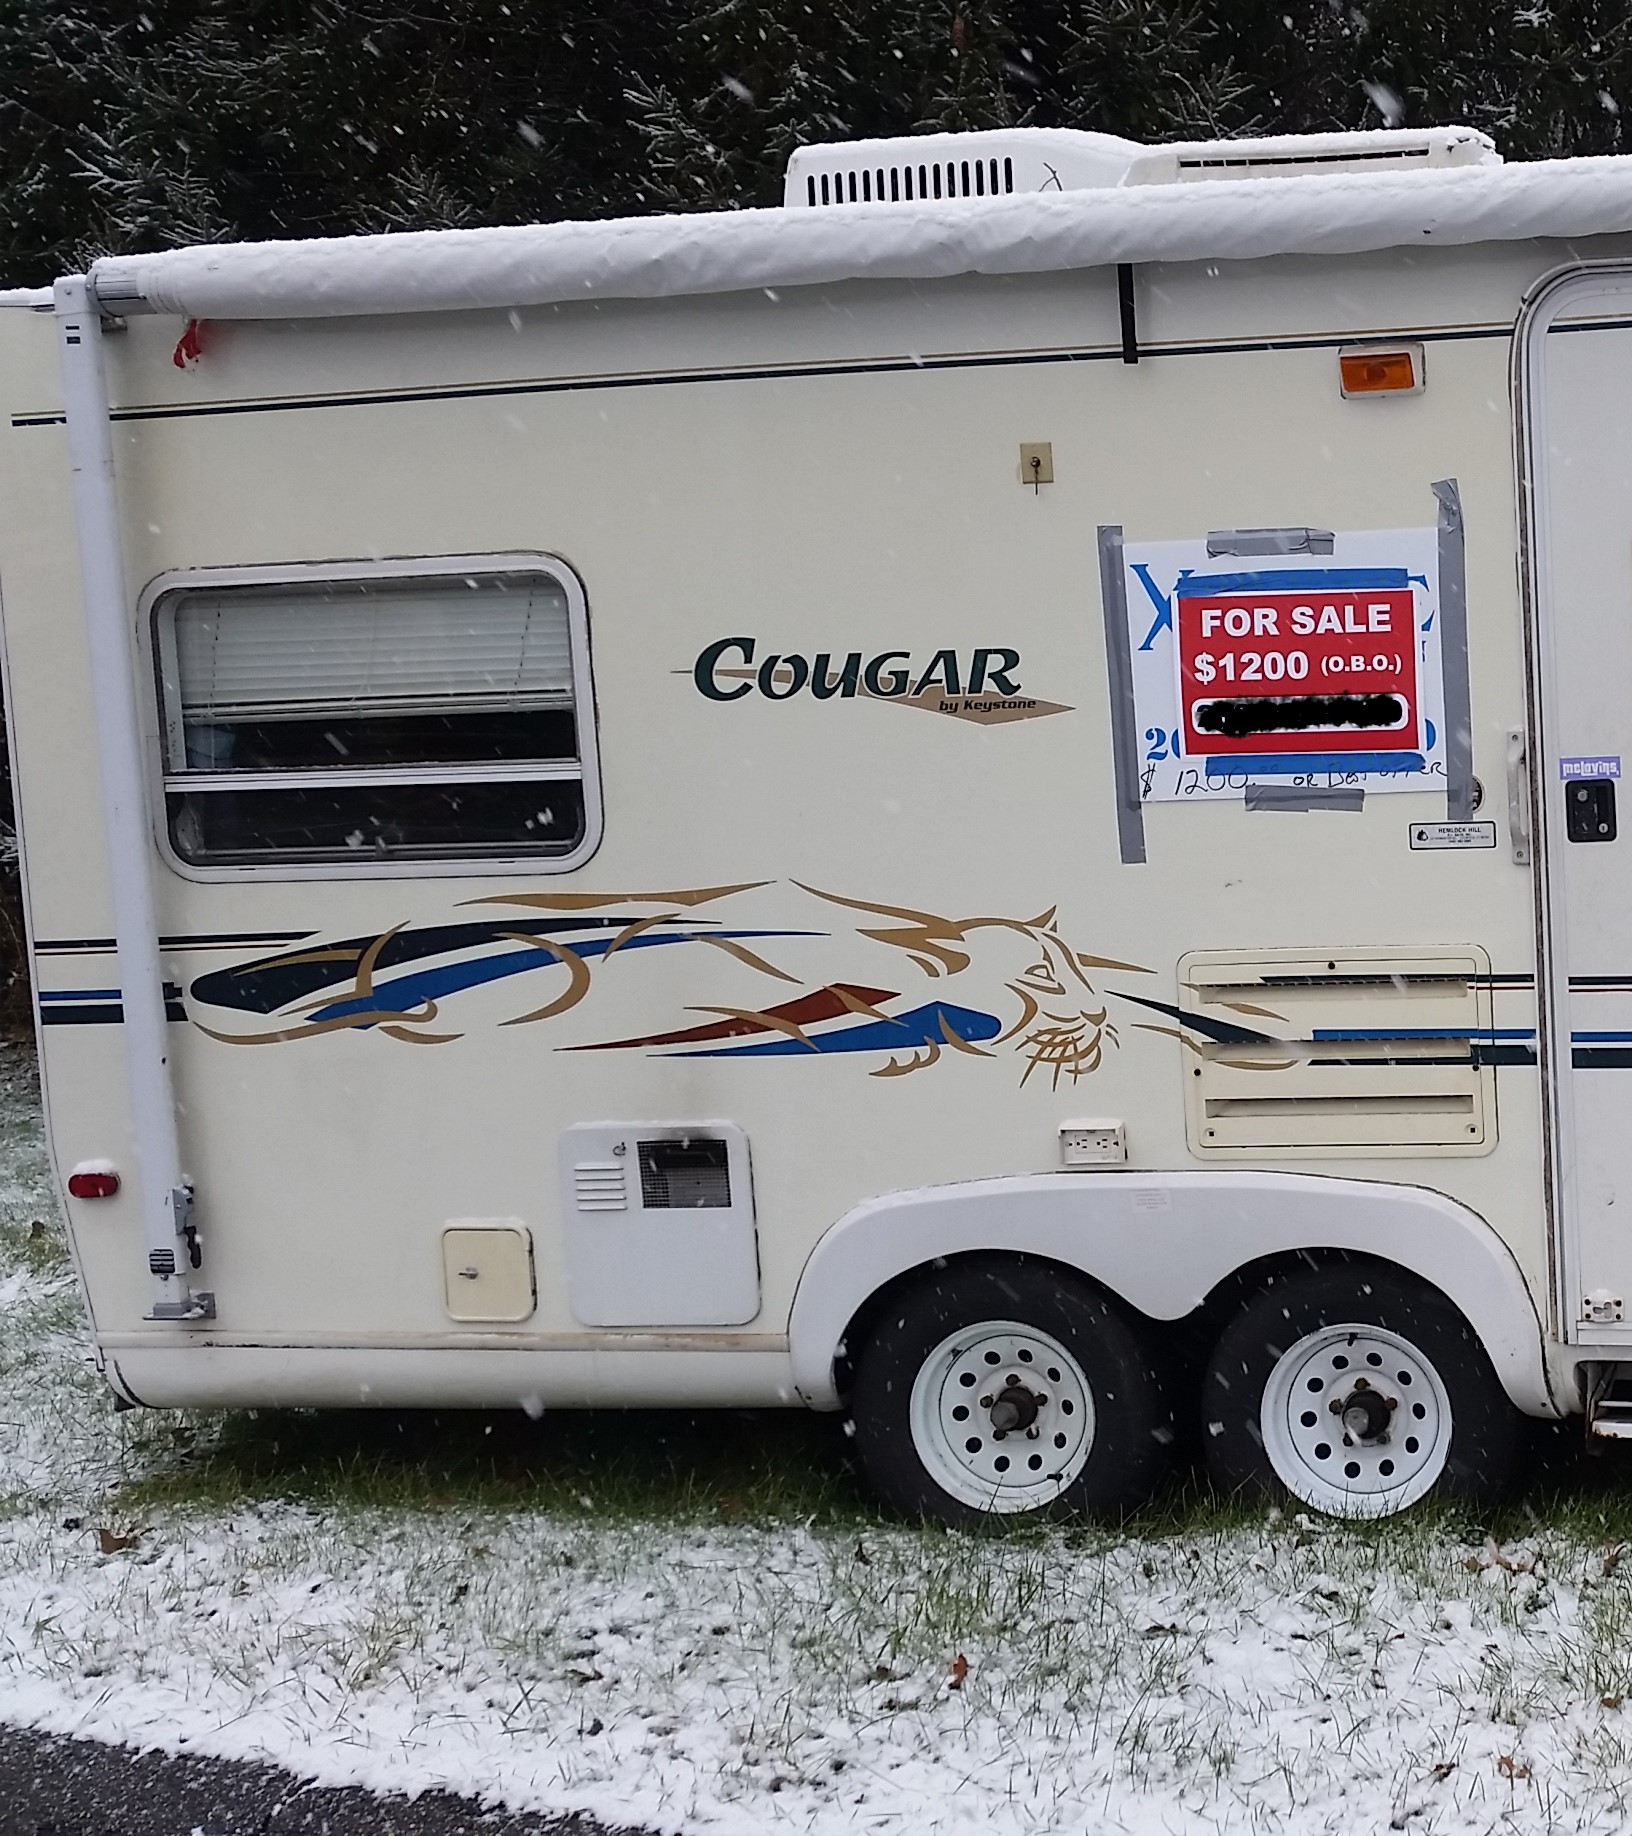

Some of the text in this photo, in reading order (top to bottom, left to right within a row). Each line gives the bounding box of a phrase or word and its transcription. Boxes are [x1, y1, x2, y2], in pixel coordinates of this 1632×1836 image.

[1201, 603, 1392, 638] FOR SALE
[1194, 651, 1402, 685] $1200 (O.B.O.)
[939, 700, 1036, 714] by Keystone
